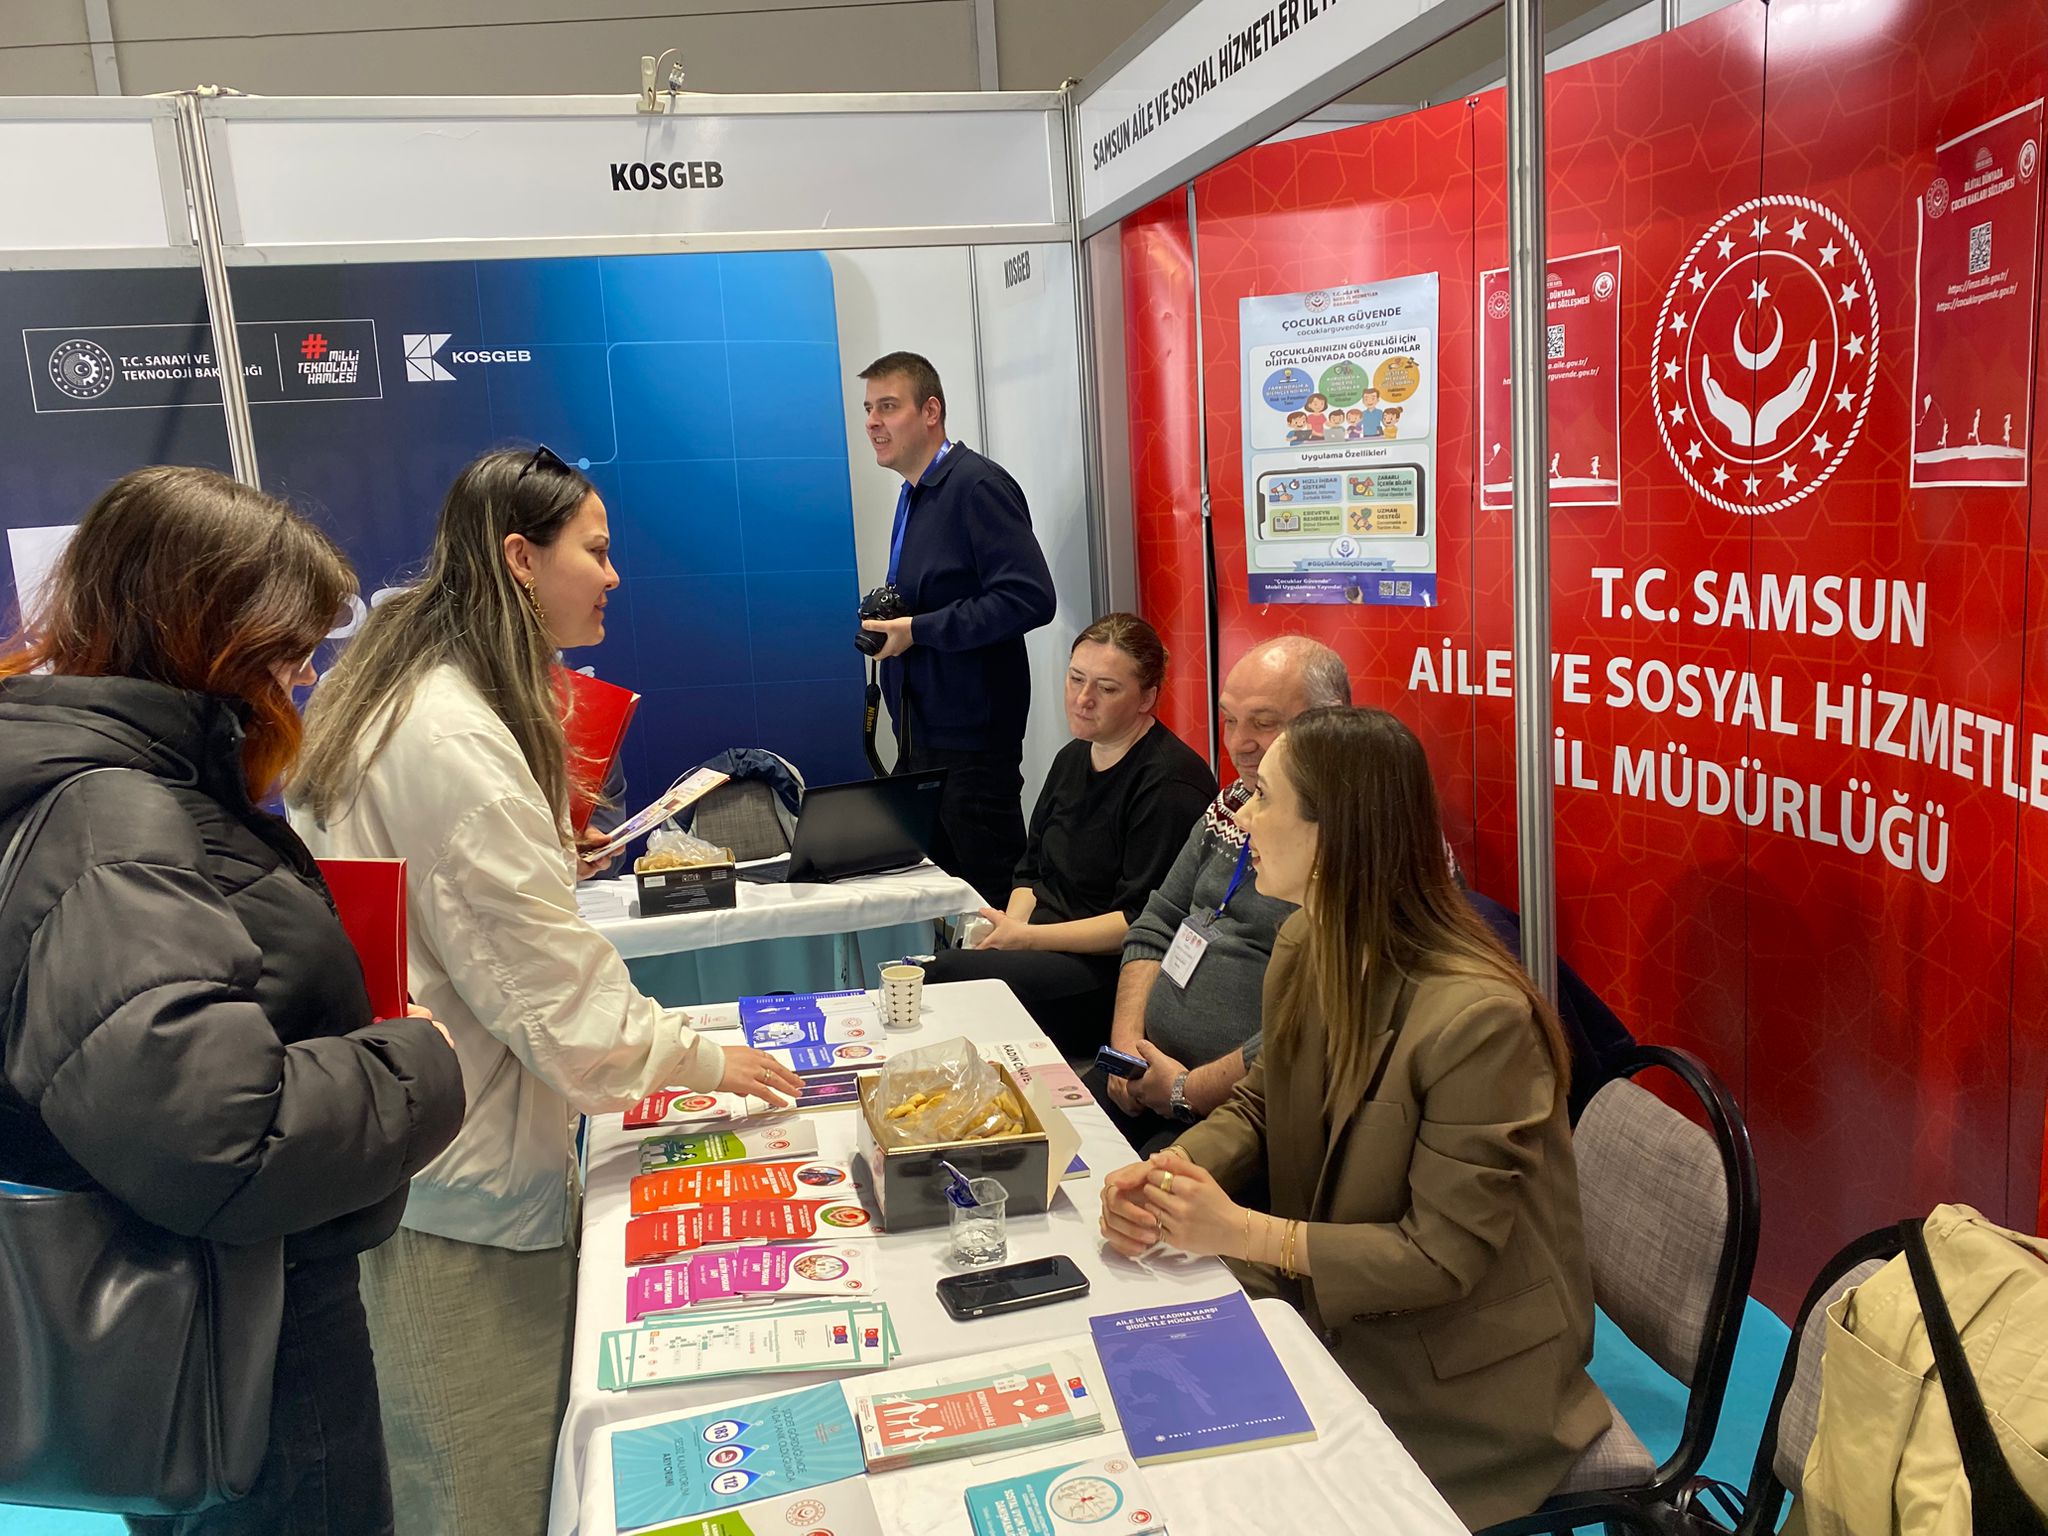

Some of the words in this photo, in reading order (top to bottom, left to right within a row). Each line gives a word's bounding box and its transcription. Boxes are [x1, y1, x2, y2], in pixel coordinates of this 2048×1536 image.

[1094, 119, 1131, 171] SAMSUN
[1132, 104, 1154, 145] AİLE
[1155, 89, 1170, 126] VE
[1172, 56, 1217, 116] SOSYAL
[1220, 0, 1300, 83] HİZMETLER
[610, 162, 724, 191] KOSGEB
[1004, 250, 1031, 289] KOSGEB
[1282, 314, 1345, 332] ÇOCUKLAR
[1348, 306, 1402, 322] GÜVENDE
[1297, 320, 1388, 337] cocuklarguvende.gov.tr
[329, 350, 360, 362] MİLLİ
[1265, 357, 1299, 367] DİJİTAL
[1301, 350, 1346, 364] DÜNYADA
[1348, 346, 1380, 359] DOĞRU
[1382, 344, 1421, 356] ADIMLAR
[1270, 342, 1347, 359] ÇOCUKLARINIZIN
[1350, 334, 1397, 350] GÜVENLİĞİ
[1400, 334, 1417, 345] İÇİN
[120, 356, 142, 367] T.C.
[145, 353, 192, 367] SANAYİ
[193, 354, 210, 364] VE
[452, 350, 531, 364] KOSGEB
[122, 367, 192, 382] TEKNOLOJİ
[298, 361, 359, 374] TEKNOLOJİ
[307, 372, 358, 385] HAMLESİ
[1301, 452, 1343, 462] Uygulama
[1344, 448, 1387, 458] Özellikleri
[1592, 568, 1680, 623] T.C.
[1693, 570, 1927, 648] SAMSUN
[1408, 637, 1513, 697] AİLE
[1552, 653, 1591, 704] E
[1605, 657, 1798, 736] SOSYAL
[866, 706, 875, 732] Nikon
[1554, 726, 1598, 791] İL
[1612, 740, 1949, 884] MÜDÜRLÜĞÜ
[1116, 1318, 1135, 1327] AİLE
[1136, 1316, 1147, 1325] İÇİ
[1148, 1315, 1159, 1323] VE
[1160, 1312, 1193, 1321] KADINA
[1194, 1307, 1218, 1317] KARŞI
[1126, 1320, 1167, 1332] ŞİDDETLE
[1168, 1313, 1212, 1325] MÜCADELE
[713, 1424, 729, 1440] 183
[722, 1474, 739, 1489] 112
